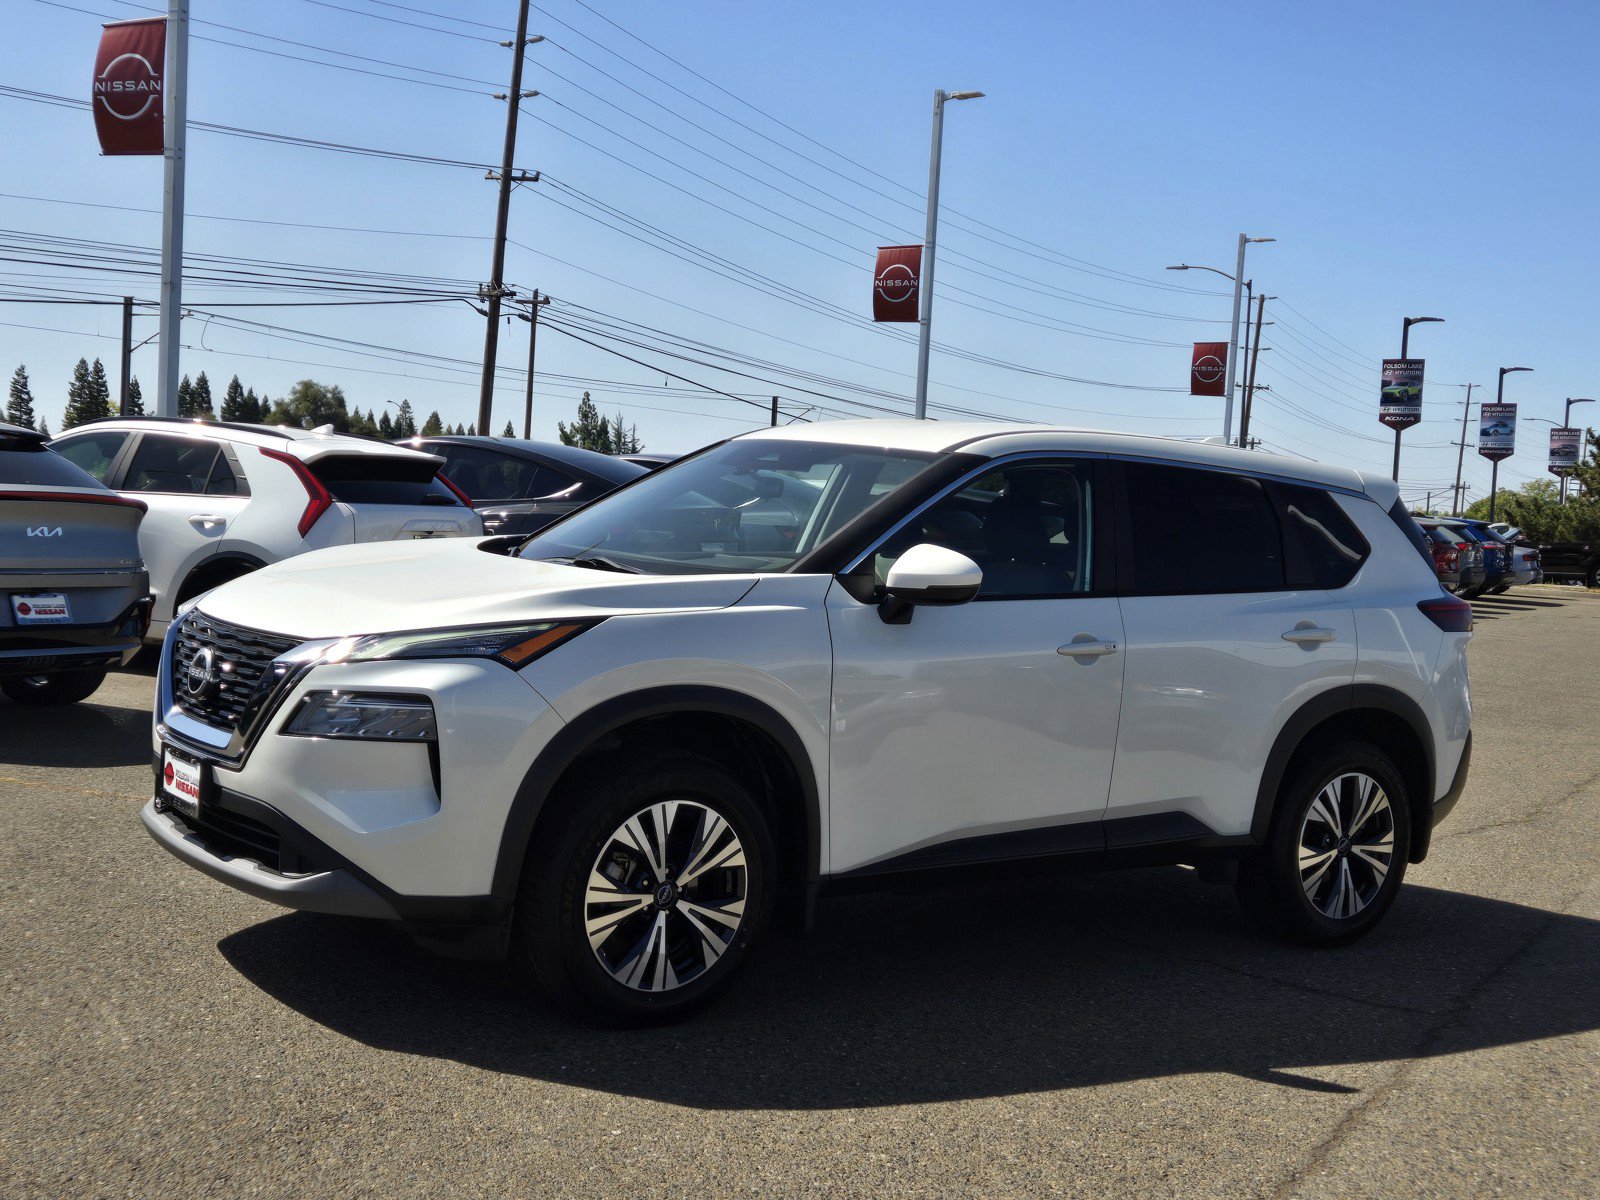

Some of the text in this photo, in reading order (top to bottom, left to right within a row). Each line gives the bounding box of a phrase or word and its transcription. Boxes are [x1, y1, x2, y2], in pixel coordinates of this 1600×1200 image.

[94, 79, 161, 92] NISSAN
[874, 279, 918, 287] NISSAN
[26, 526, 63, 537] KIA
[188, 666, 211, 680] ISSAN
[175, 778, 200, 799] NISSAN
